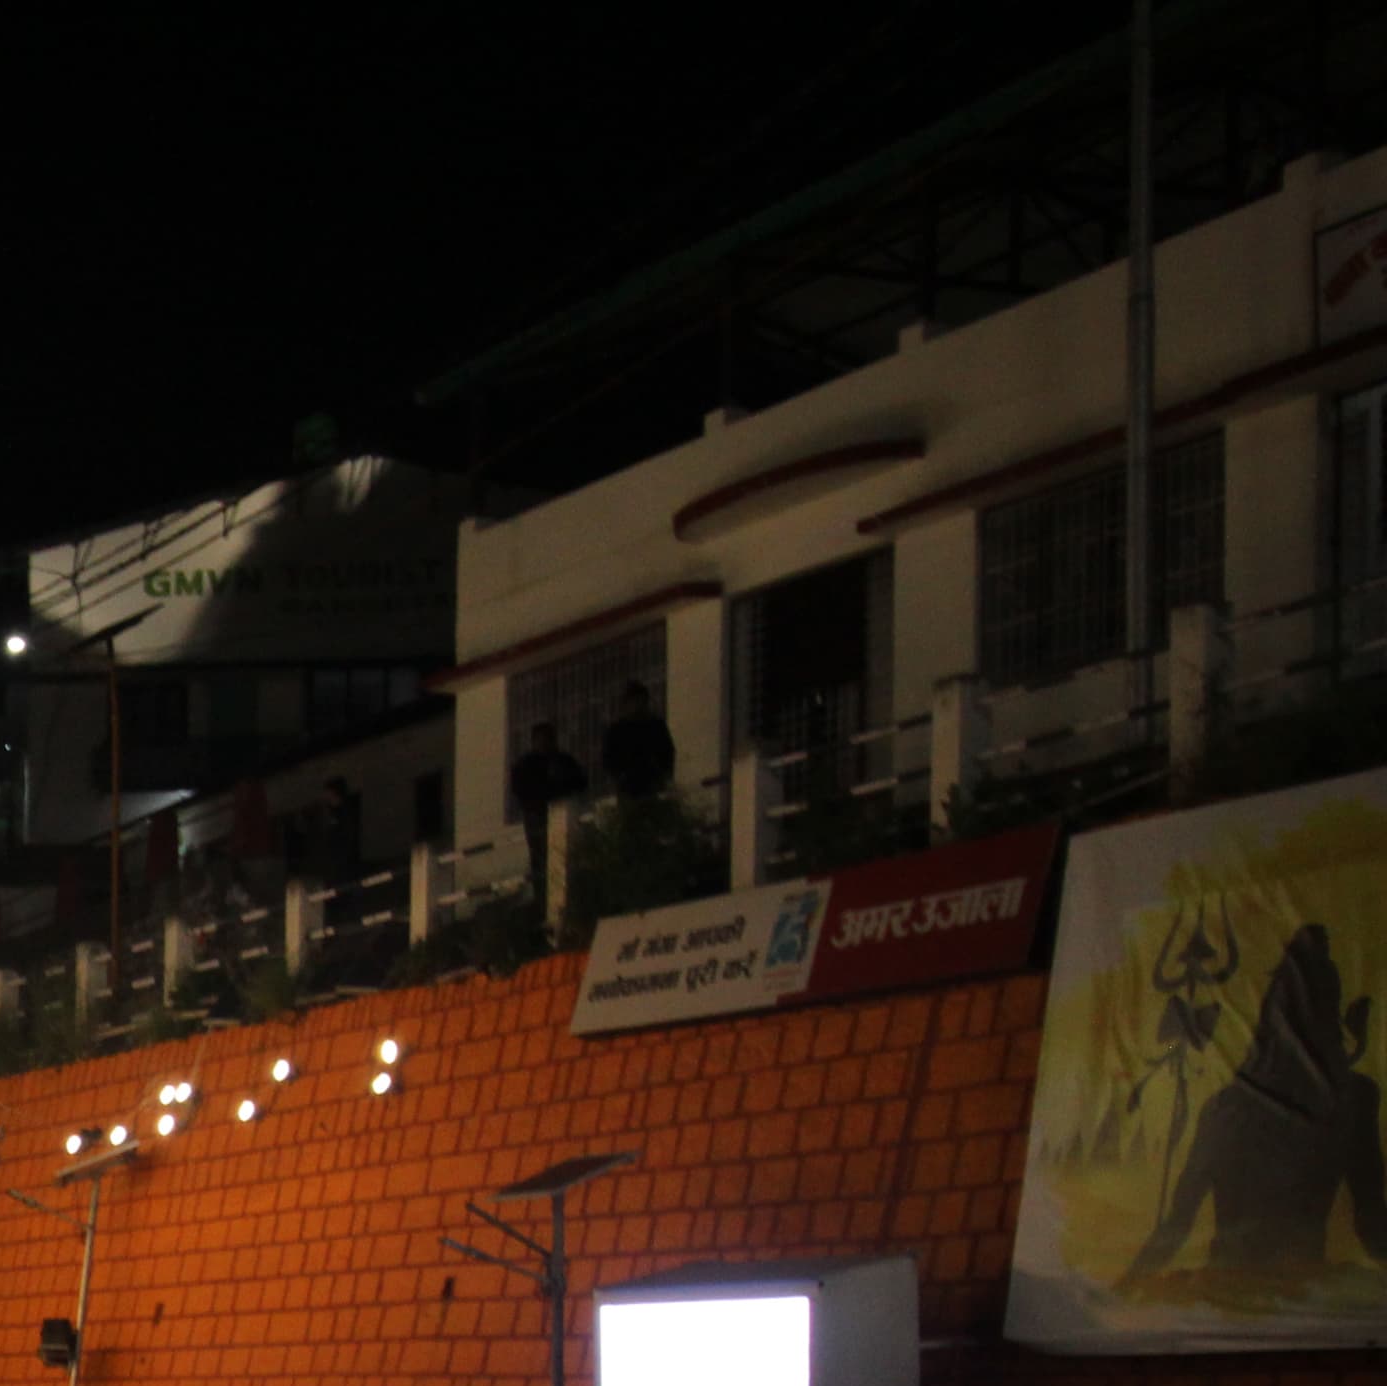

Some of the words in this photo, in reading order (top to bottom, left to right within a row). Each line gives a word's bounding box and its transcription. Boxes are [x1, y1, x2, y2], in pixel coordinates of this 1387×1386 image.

[143, 566, 264, 598] GMVN
[830, 898, 914, 951] अमर
[912, 876, 1027, 934] उजाला
